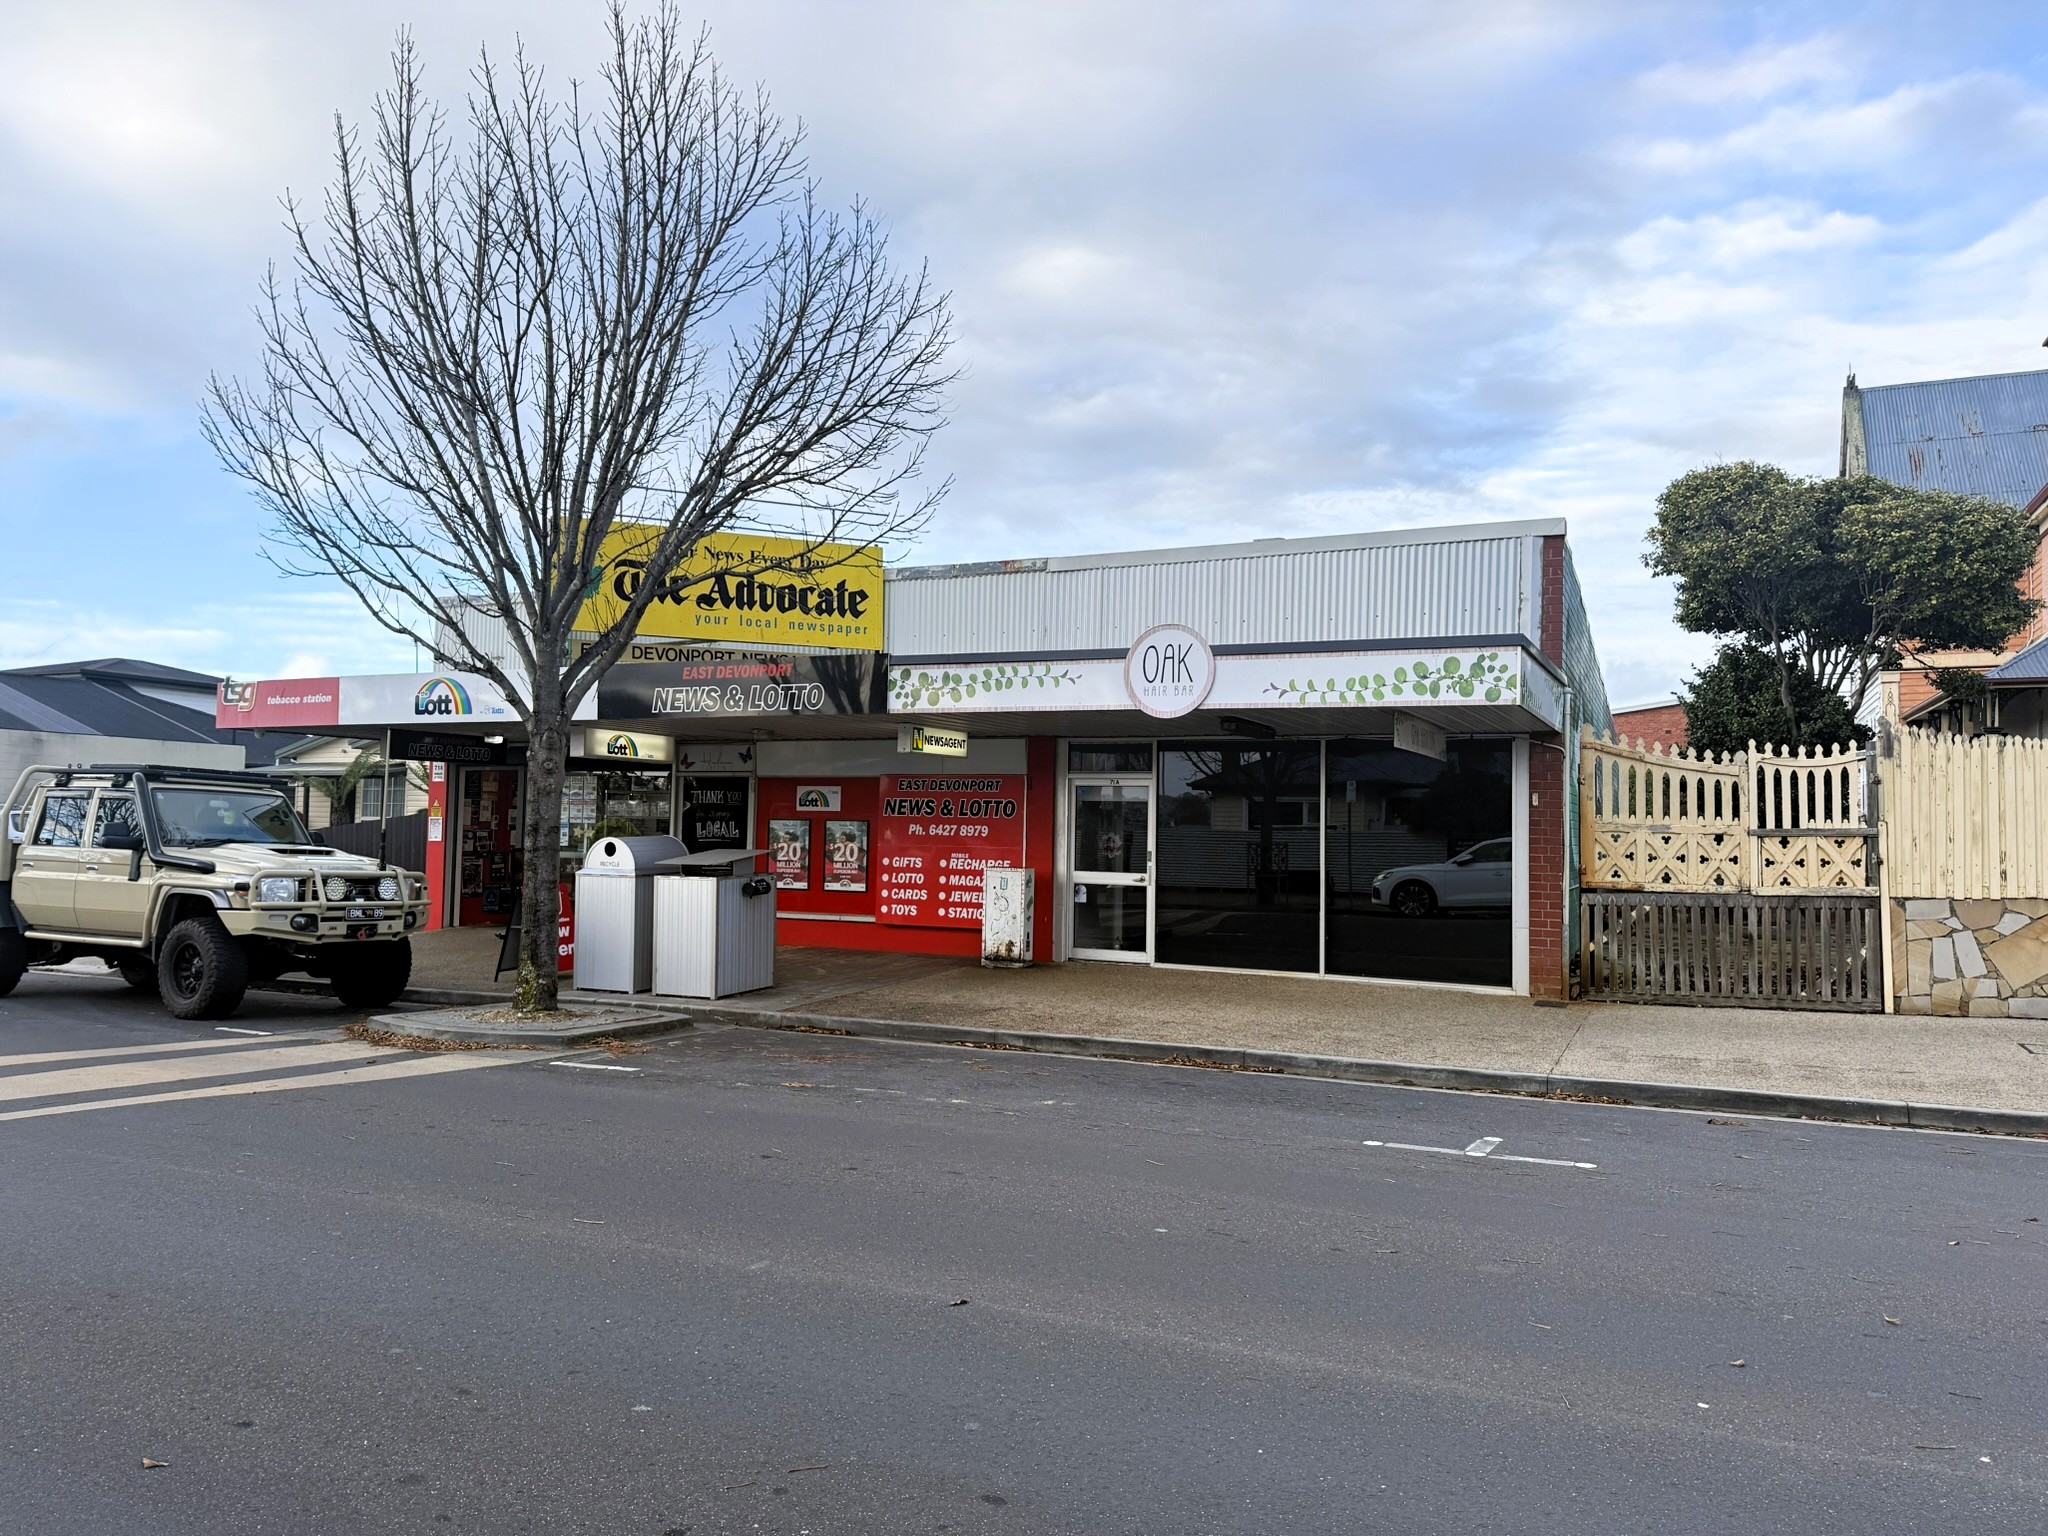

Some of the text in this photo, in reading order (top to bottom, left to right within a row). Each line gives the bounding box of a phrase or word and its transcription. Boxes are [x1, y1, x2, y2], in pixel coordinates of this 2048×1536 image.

[703, 545, 744, 562] News
[750, 549, 794, 568] Every
[696, 573, 869, 619] Advocate
[695, 614, 868, 636] your local newspaper
[631, 645, 735, 662] DEVONPORT
[682, 663, 794, 680] EAST DEVONPORT
[1142, 643, 1194, 683] OAK
[222, 676, 332, 712] tsg tobacco station
[652, 682, 825, 713] NEWS & LOTTO
[1143, 684, 1194, 697] HAIR BAR
[415, 695, 452, 715] Lott
[607, 742, 628, 756] Lott
[924, 734, 966, 749] NEWSAGENT
[407, 743, 491, 761] NEWS & LOTTO
[898, 779, 1002, 792] EAST DEVONPORT
[690, 790, 742, 803] THANK YOU
[799, 796, 819, 807] Lott
[883, 798, 1017, 819] NEWS & LOTTO
[696, 820, 739, 838] LOCAL
[908, 824, 989, 837] Ph. 6427 8979
[774, 843, 801, 861] $20
[830, 843, 859, 862] $20
[833, 861, 858, 869] MILLION
[892, 856, 922, 868] GIFTS
[949, 859, 1011, 870] RECHARGE
[891, 872, 925, 884] LOTTO
[891, 888, 928, 900] CARDS
[891, 904, 917, 916] TOYS
